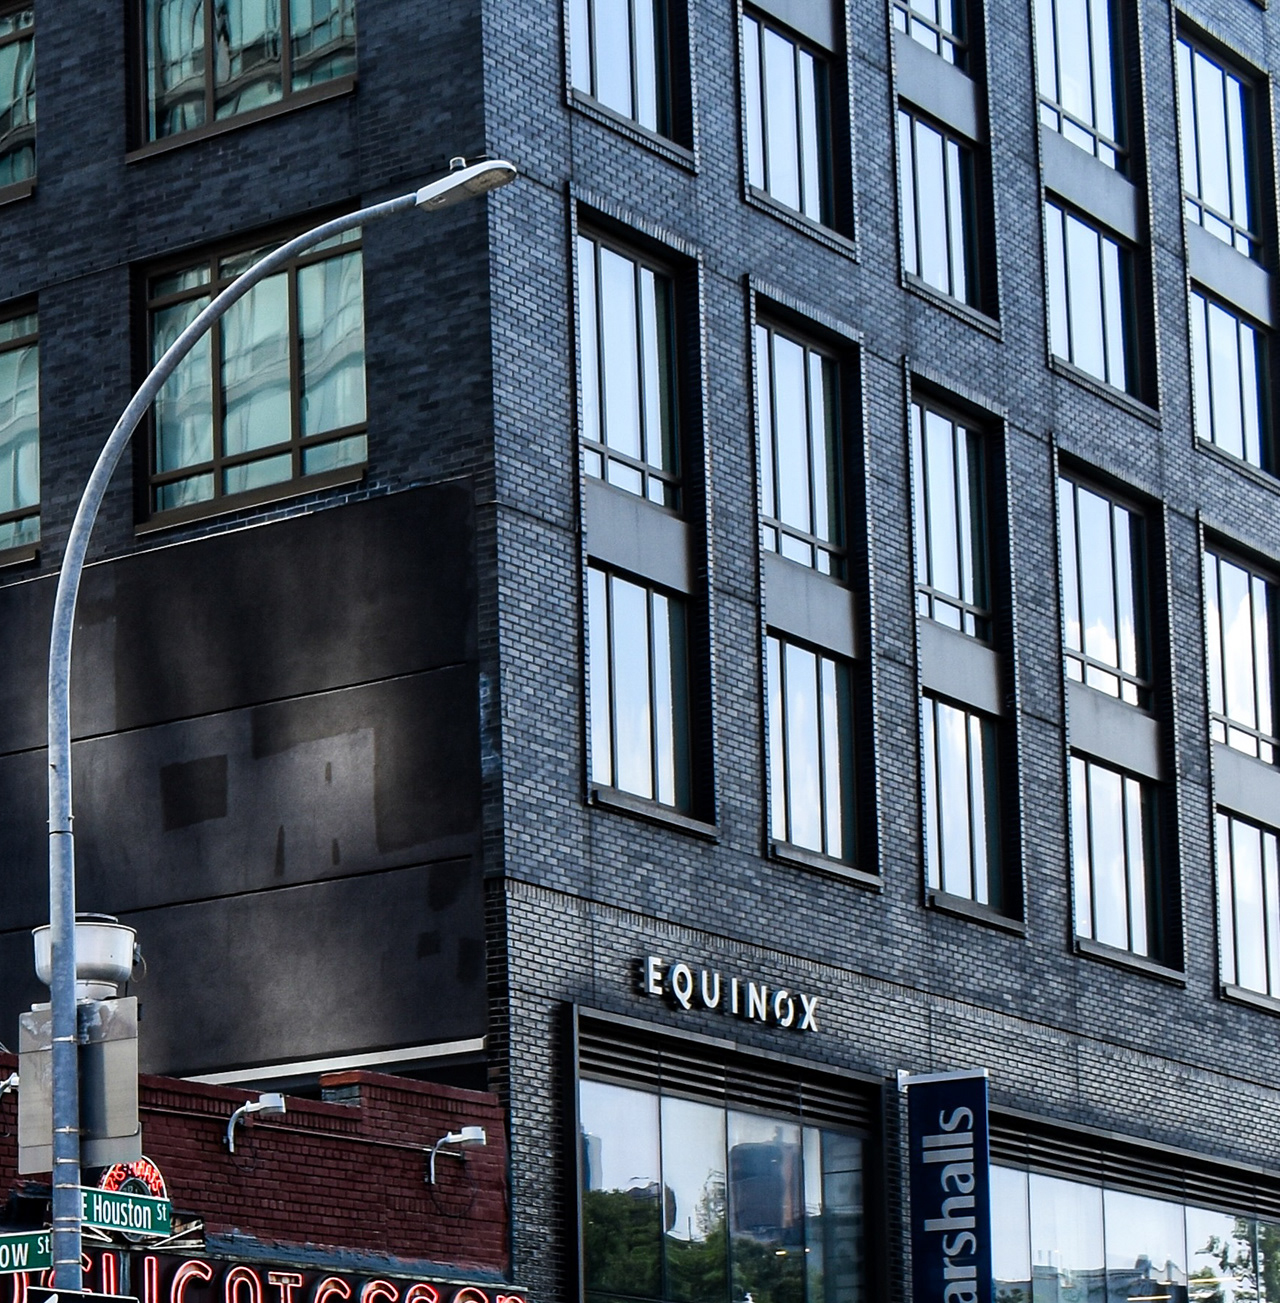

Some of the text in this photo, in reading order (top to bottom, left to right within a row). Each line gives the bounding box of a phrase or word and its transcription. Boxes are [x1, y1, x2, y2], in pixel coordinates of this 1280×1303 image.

[646, 956, 819, 1031] EQUINOX
[93, 1191, 152, 1231] Houston
[156, 1202, 167, 1221] St
[37, 1236, 50, 1254] St
